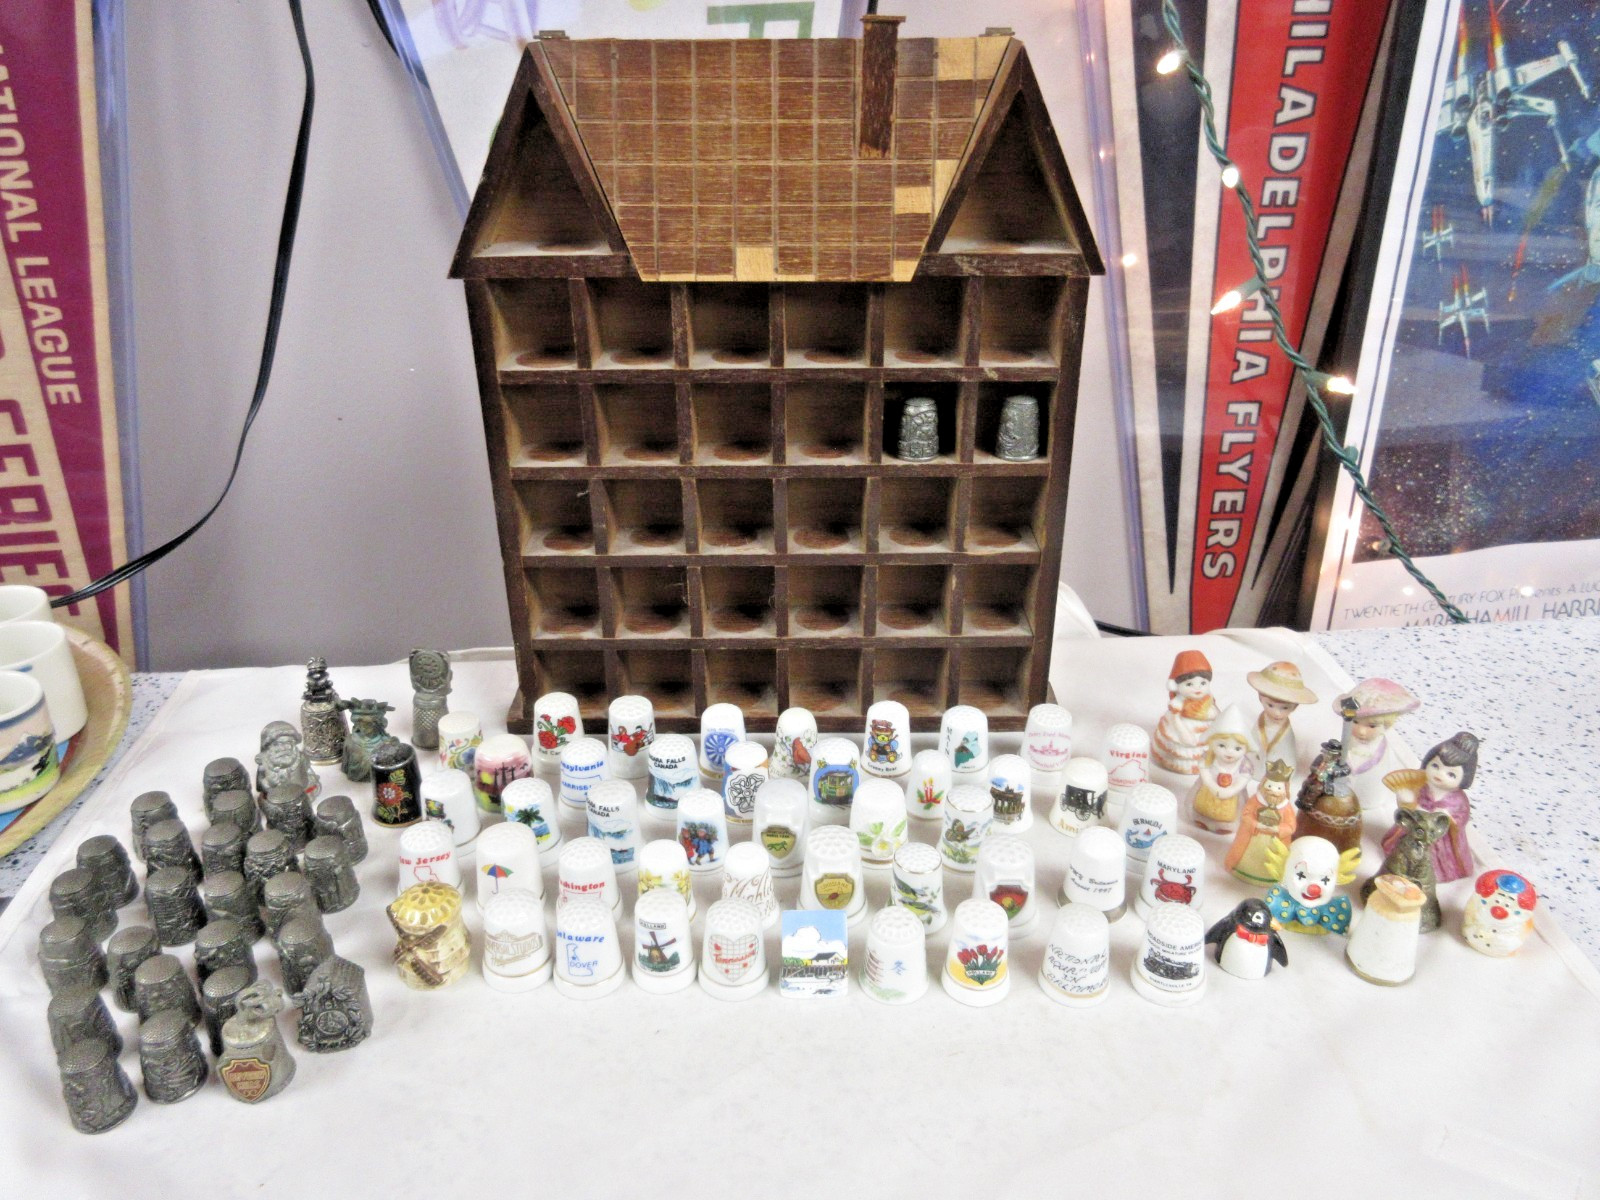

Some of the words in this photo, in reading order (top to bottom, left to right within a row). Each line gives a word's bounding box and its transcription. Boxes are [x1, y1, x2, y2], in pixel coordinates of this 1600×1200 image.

[14, 256, 82, 405] LEAGUE
[1202, 400, 1262, 580] FLYERS
[1344, 603, 1420, 620] TWENTIETH
[1479, 589, 1504, 603] FOX
[654, 762, 678, 770] CANADA
[666, 756, 686, 764] FALLS
[1132, 817, 1163, 830] BERMUDA
[416, 851, 452, 866] Jersey
[1157, 860, 1197, 875] MARYLAND
